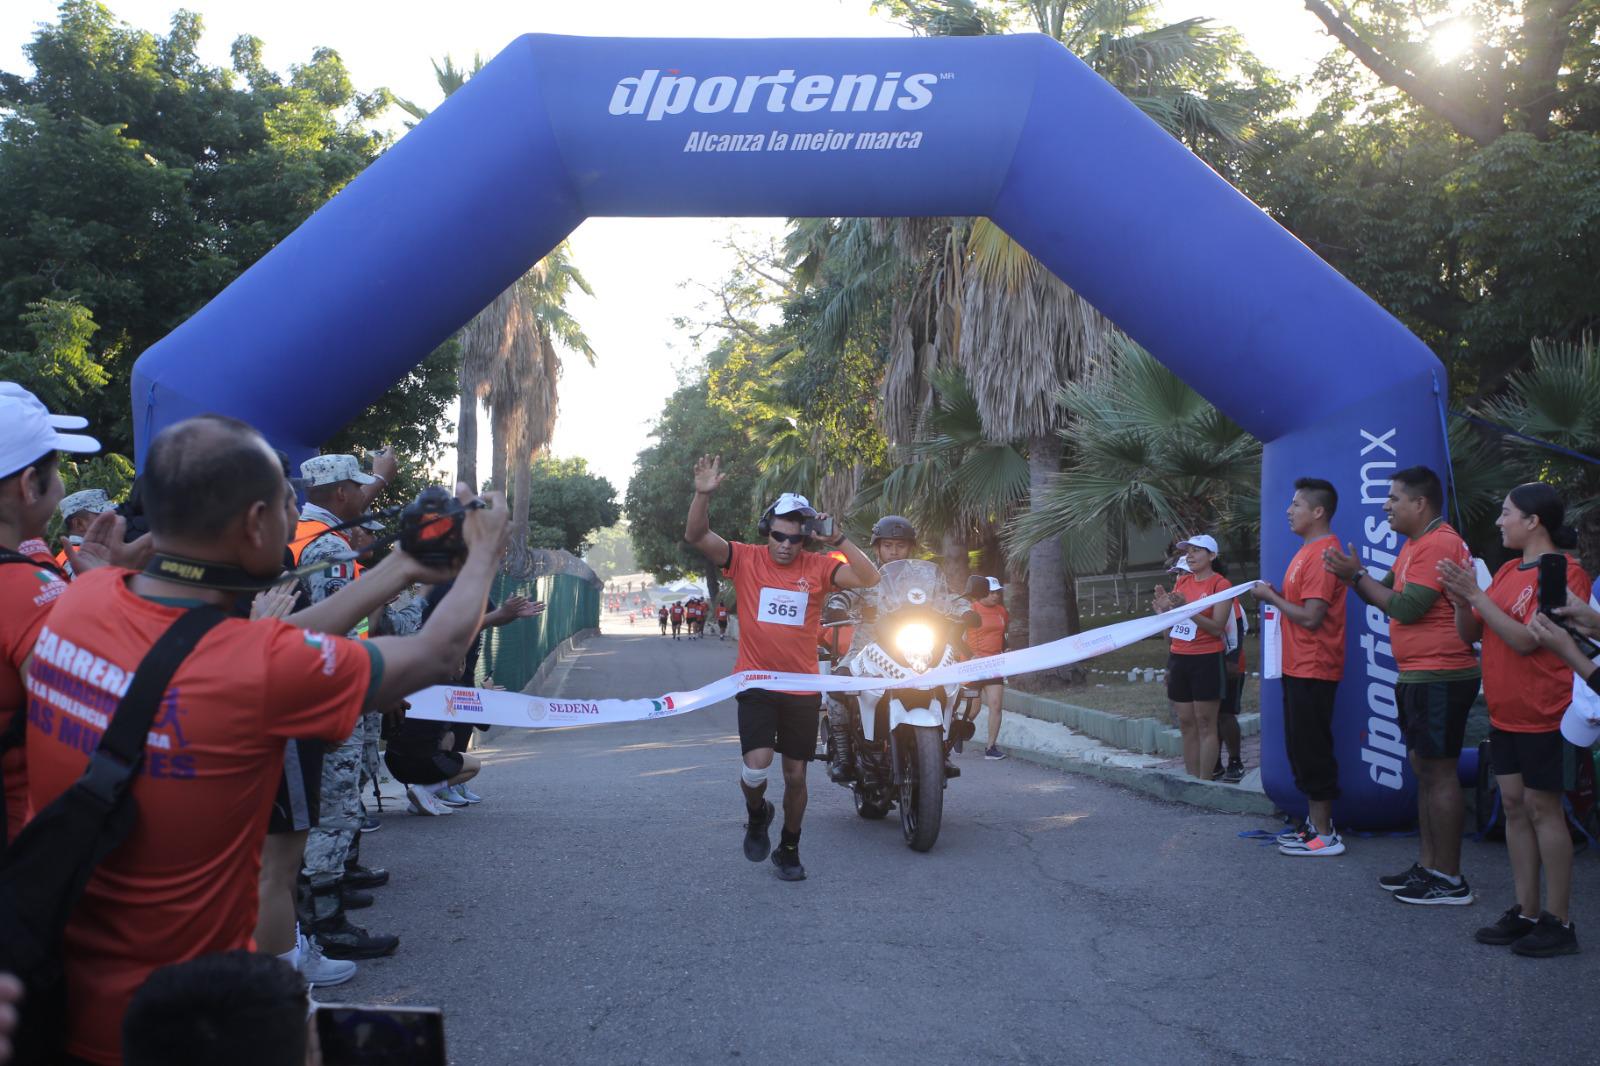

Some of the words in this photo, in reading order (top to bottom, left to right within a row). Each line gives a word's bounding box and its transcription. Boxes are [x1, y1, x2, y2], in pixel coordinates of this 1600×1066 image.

[609, 69, 937, 120] dportenis
[684, 131, 763, 152] Alcanza
[767, 130, 787, 151] la
[790, 130, 853, 151] mejor
[855, 131, 922, 149] marca
[767, 603, 798, 618] 365
[1174, 624, 1190, 635] 299
[549, 703, 600, 714] SEDENA
